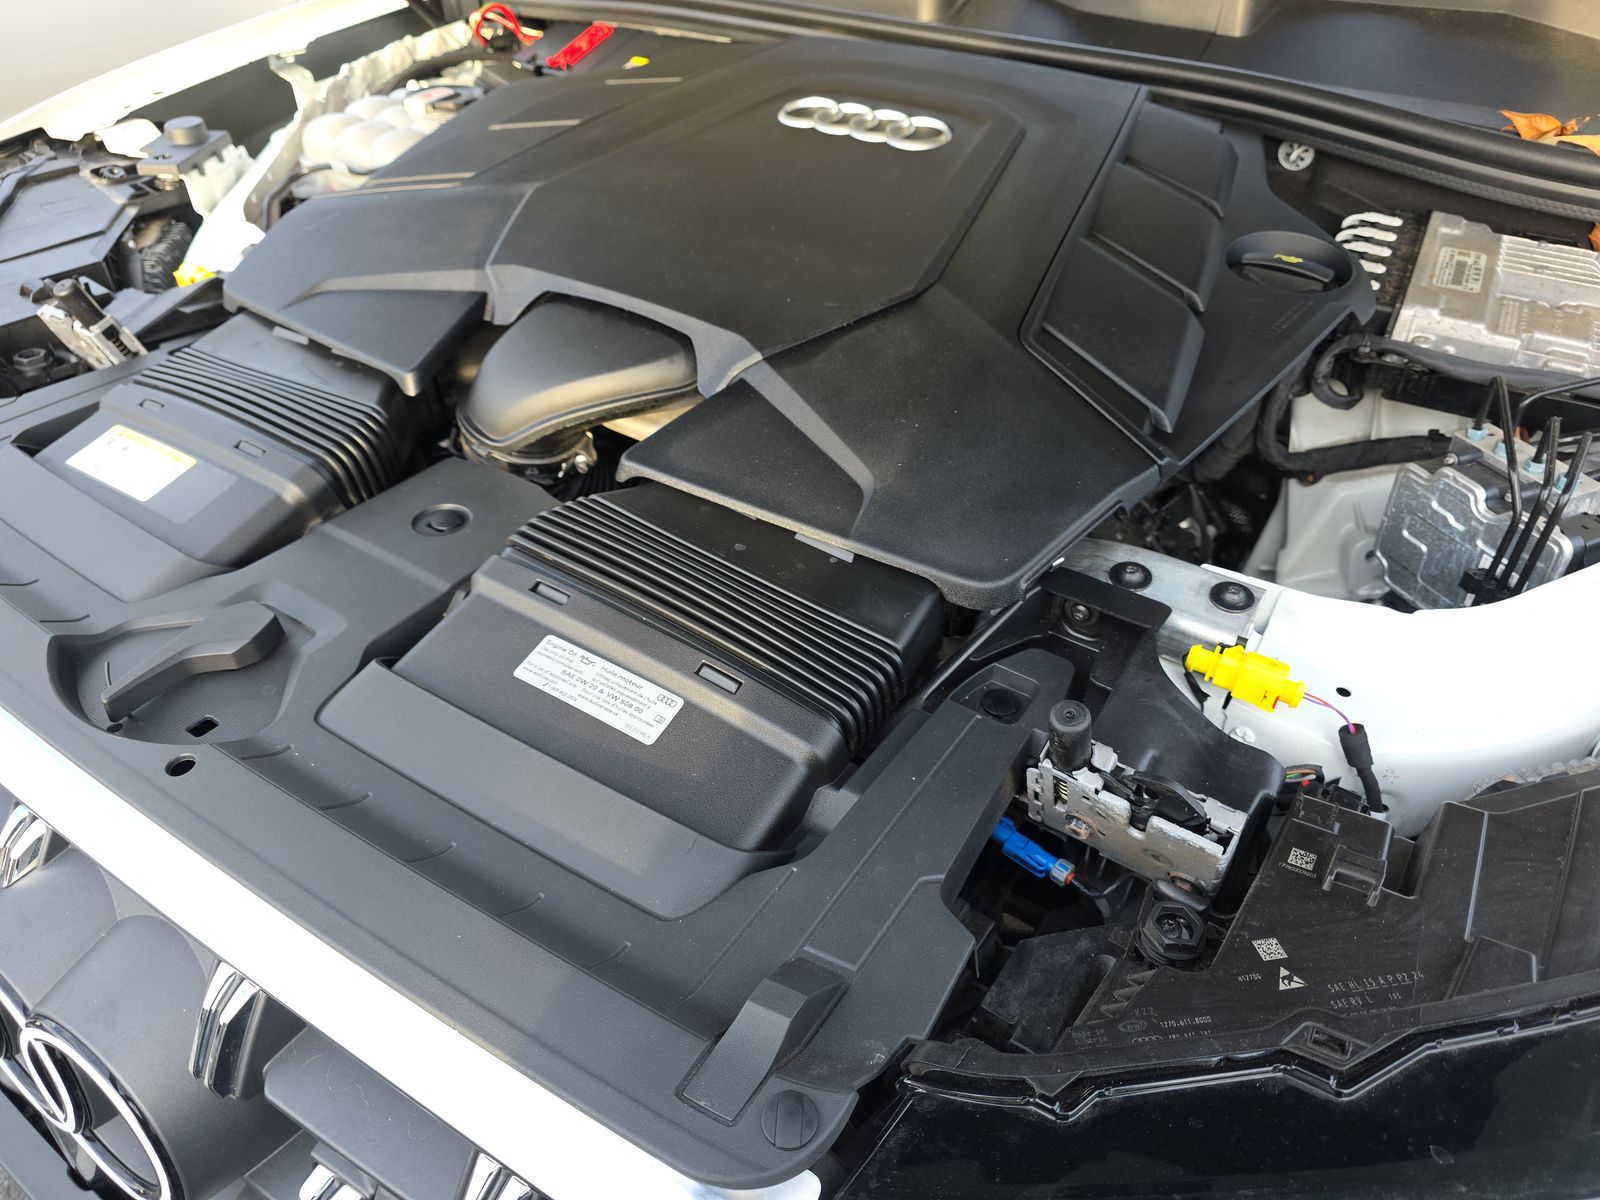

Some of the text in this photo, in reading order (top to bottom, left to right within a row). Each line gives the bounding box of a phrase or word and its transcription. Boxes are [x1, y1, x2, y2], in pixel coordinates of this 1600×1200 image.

[546, 640, 568, 653] Engine
[601, 666, 645, 690] Huile moteur
[560, 669, 577, 679] SAE
[575, 676, 599, 691] 0W-20
[605, 691, 621, 702] VW
[619, 699, 634, 709] 508
[633, 706, 645, 714] 00
[1328, 982, 1346, 993] SAE
[1348, 980, 1360, 990] HL
[1378, 976, 1386, 985] A
[1387, 974, 1393, 983] P
[1396, 972, 1409, 982] P2
[1411, 970, 1424, 980] 24
[1331, 998, 1349, 1009] SAE
[1160, 1015, 1212, 1029] 1270.611.8000
